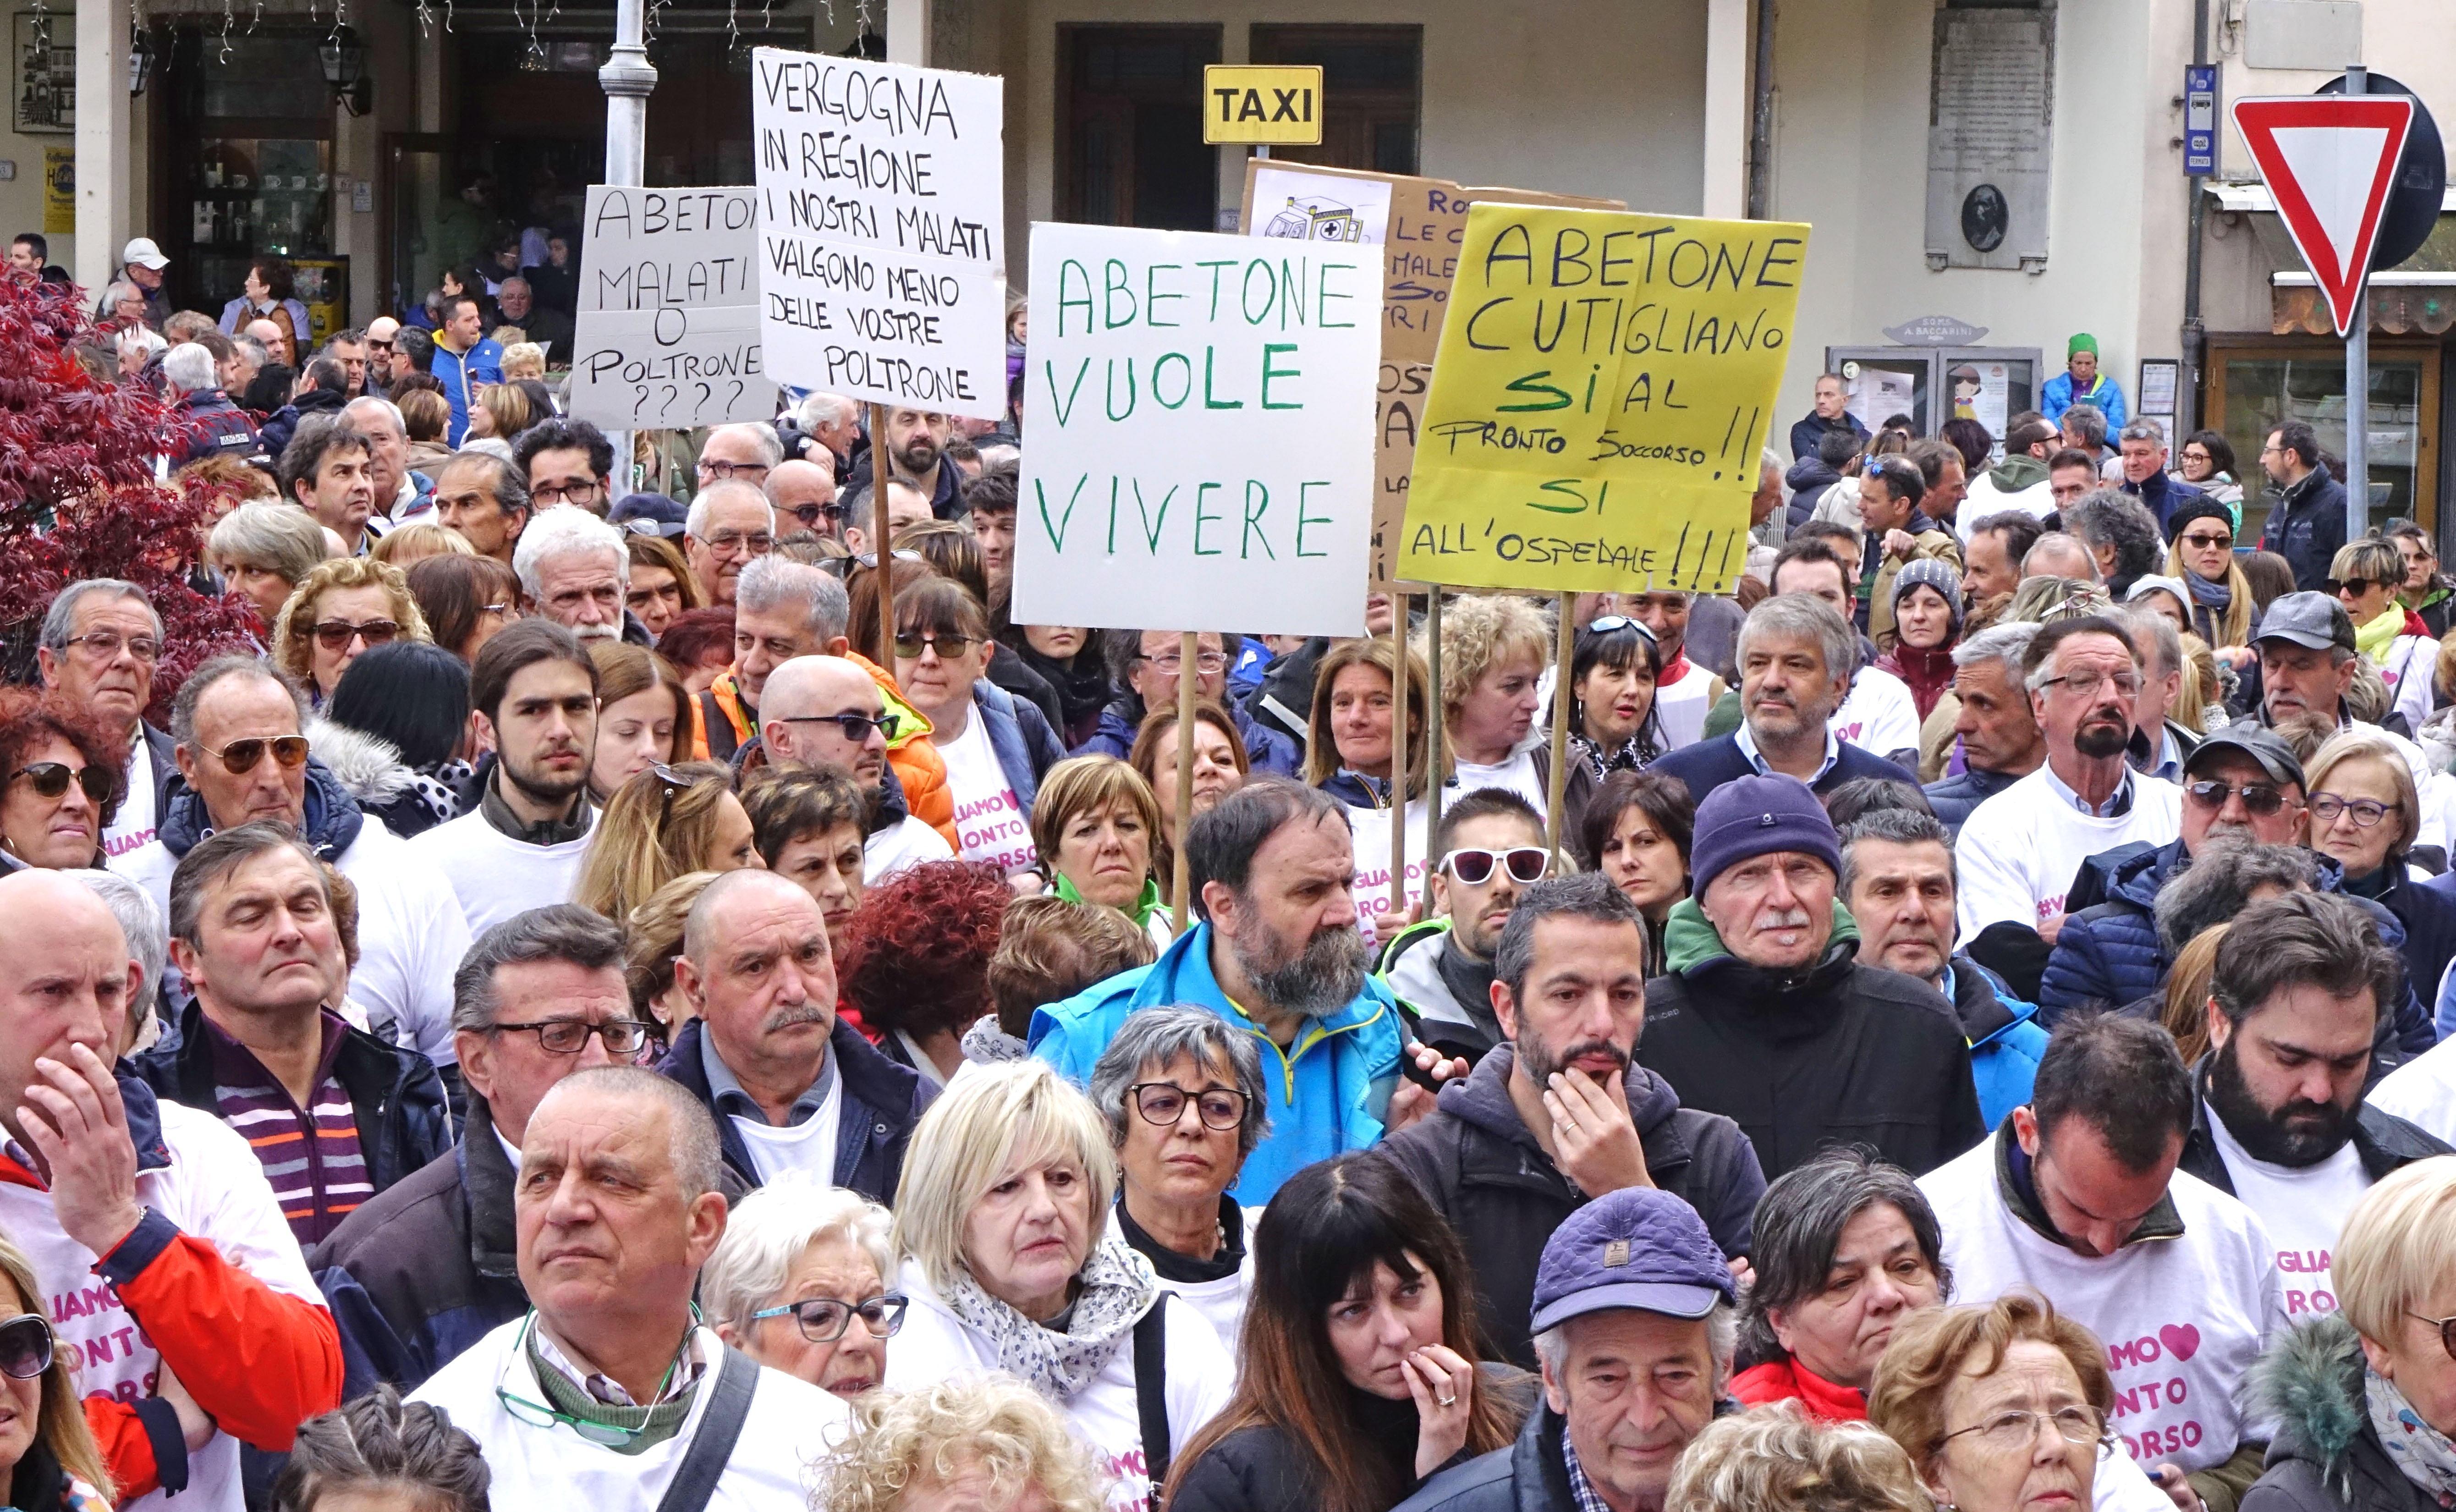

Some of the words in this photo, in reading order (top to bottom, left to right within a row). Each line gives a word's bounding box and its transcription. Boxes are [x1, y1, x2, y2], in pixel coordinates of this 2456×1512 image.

[760, 60, 958, 139] VERGOGNA
[1213, 88, 1311, 122] TAXI
[763, 128, 789, 171] IN
[802, 132, 937, 196] REGIONE
[596, 190, 757, 239] ABETO
[766, 188, 774, 221] I
[790, 188, 879, 238] NOSTRI
[896, 206, 991, 261] MALATI
[1397, 216, 1436, 241] LE
[599, 257, 747, 310] MALATI
[768, 236, 874, 292] VALGONO
[887, 266, 959, 306] MENO
[1486, 223, 1802, 293] ABETONE
[769, 292, 832, 330] DELLE
[847, 308, 943, 346] VOSTRE
[1058, 257, 1357, 337] ABETONE
[1384, 305, 1429, 332] RI
[654, 308, 687, 346] O
[1467, 297, 1784, 356] CUTIGLIANO
[580, 345, 761, 384] POLTRONE
[824, 346, 977, 401] POLTRONE
[1046, 344, 1304, 428] VUOLE
[1377, 365, 1433, 394] OS
[1624, 372, 1689, 414] AL
[1429, 419, 1566, 456] PRONTO
[1035, 473, 1334, 561] VIVERE
[1526, 480, 1608, 516] SI
